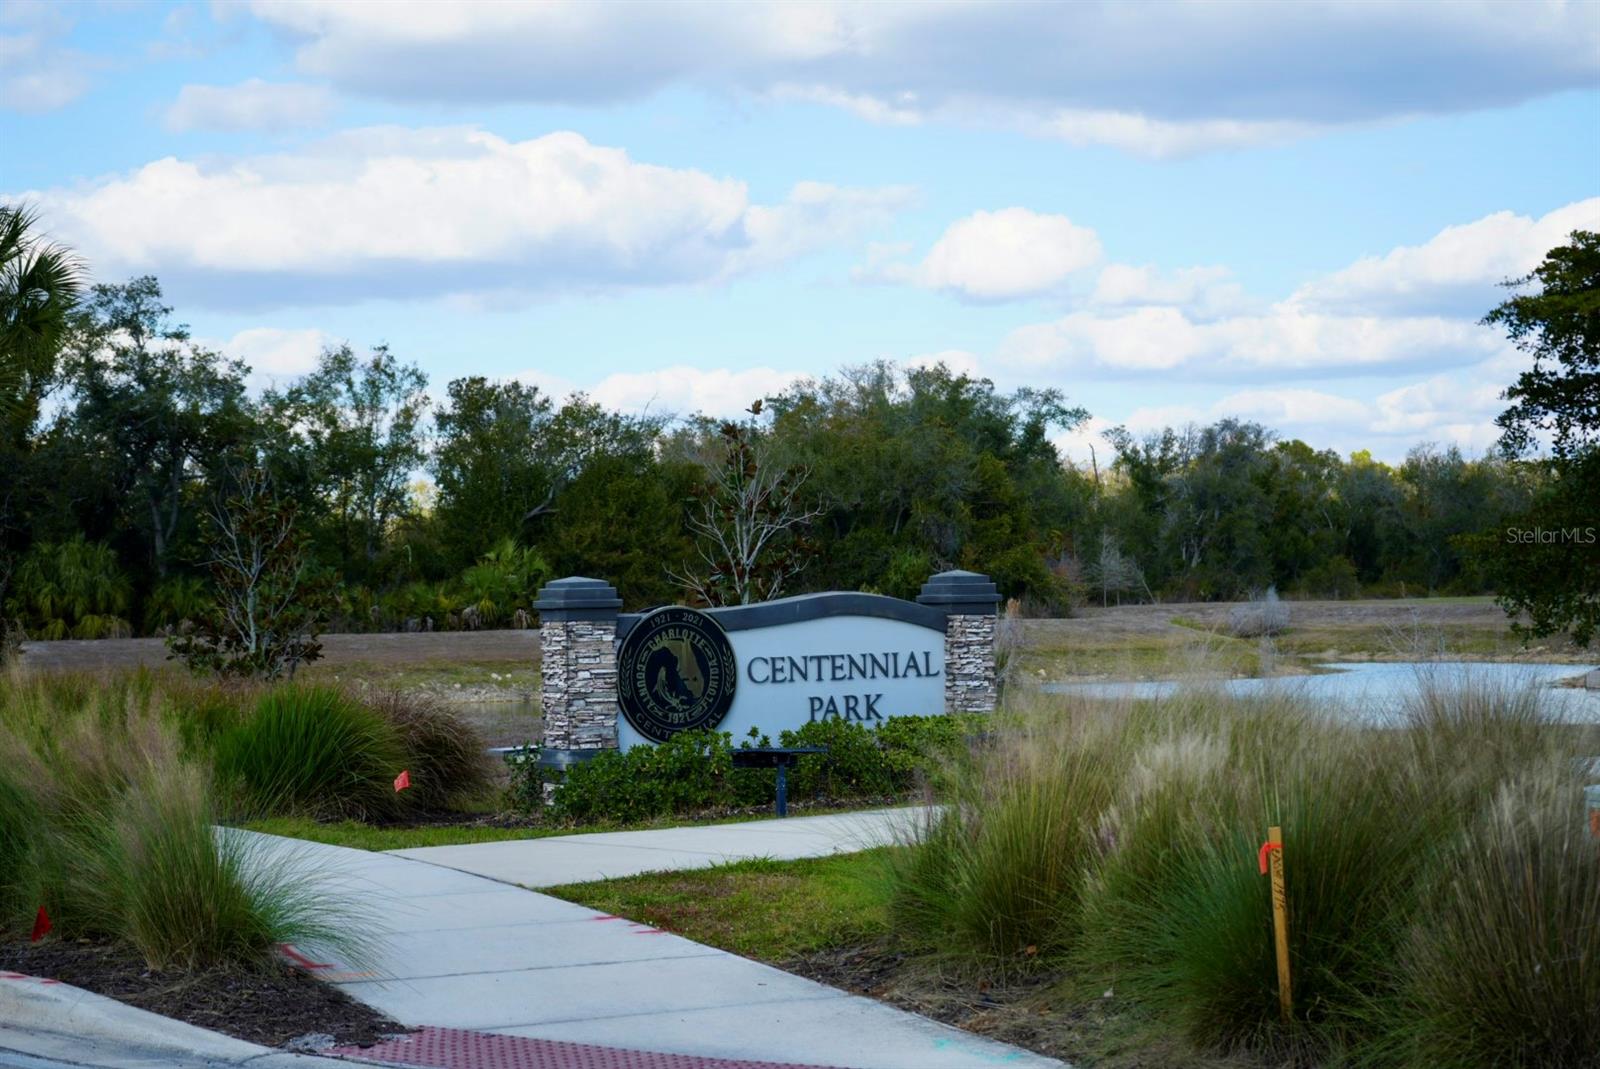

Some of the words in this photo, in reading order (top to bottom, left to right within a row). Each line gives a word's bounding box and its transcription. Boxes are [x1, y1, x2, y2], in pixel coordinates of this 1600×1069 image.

[650, 613, 671, 628] 1921
[682, 612, 704, 626] 2021
[648, 628, 706, 651] CHARLOTTE
[746, 650, 941, 684] CENTENNIAL
[636, 664, 656, 711] COUNTY
[702, 658, 720, 711] FLORIDA
[808, 693, 884, 722] PARK
[635, 711, 723, 741] CENTIAL
